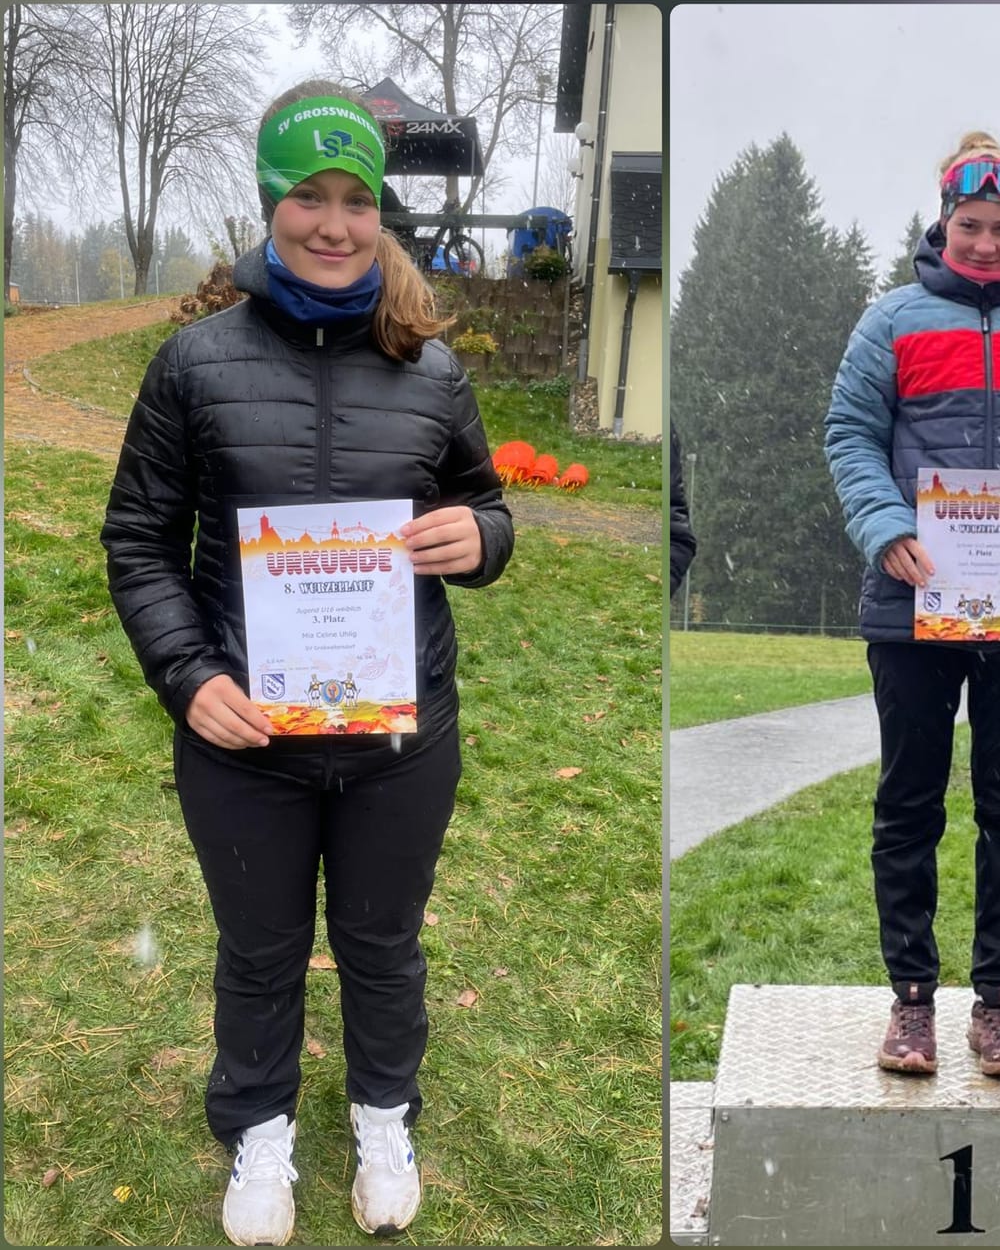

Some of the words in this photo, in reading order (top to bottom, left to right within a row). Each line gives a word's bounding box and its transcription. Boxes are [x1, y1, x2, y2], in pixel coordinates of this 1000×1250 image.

[278, 118, 290, 135] SV
[406, 121, 462, 134] 24MX
[267, 548, 392, 576] URKUNDE
[284, 583, 296, 594] 8.
[299, 580, 374, 594] WURZELLAUF
[323, 614, 346, 623] Platz
[936, 1144, 986, 1234] 1
